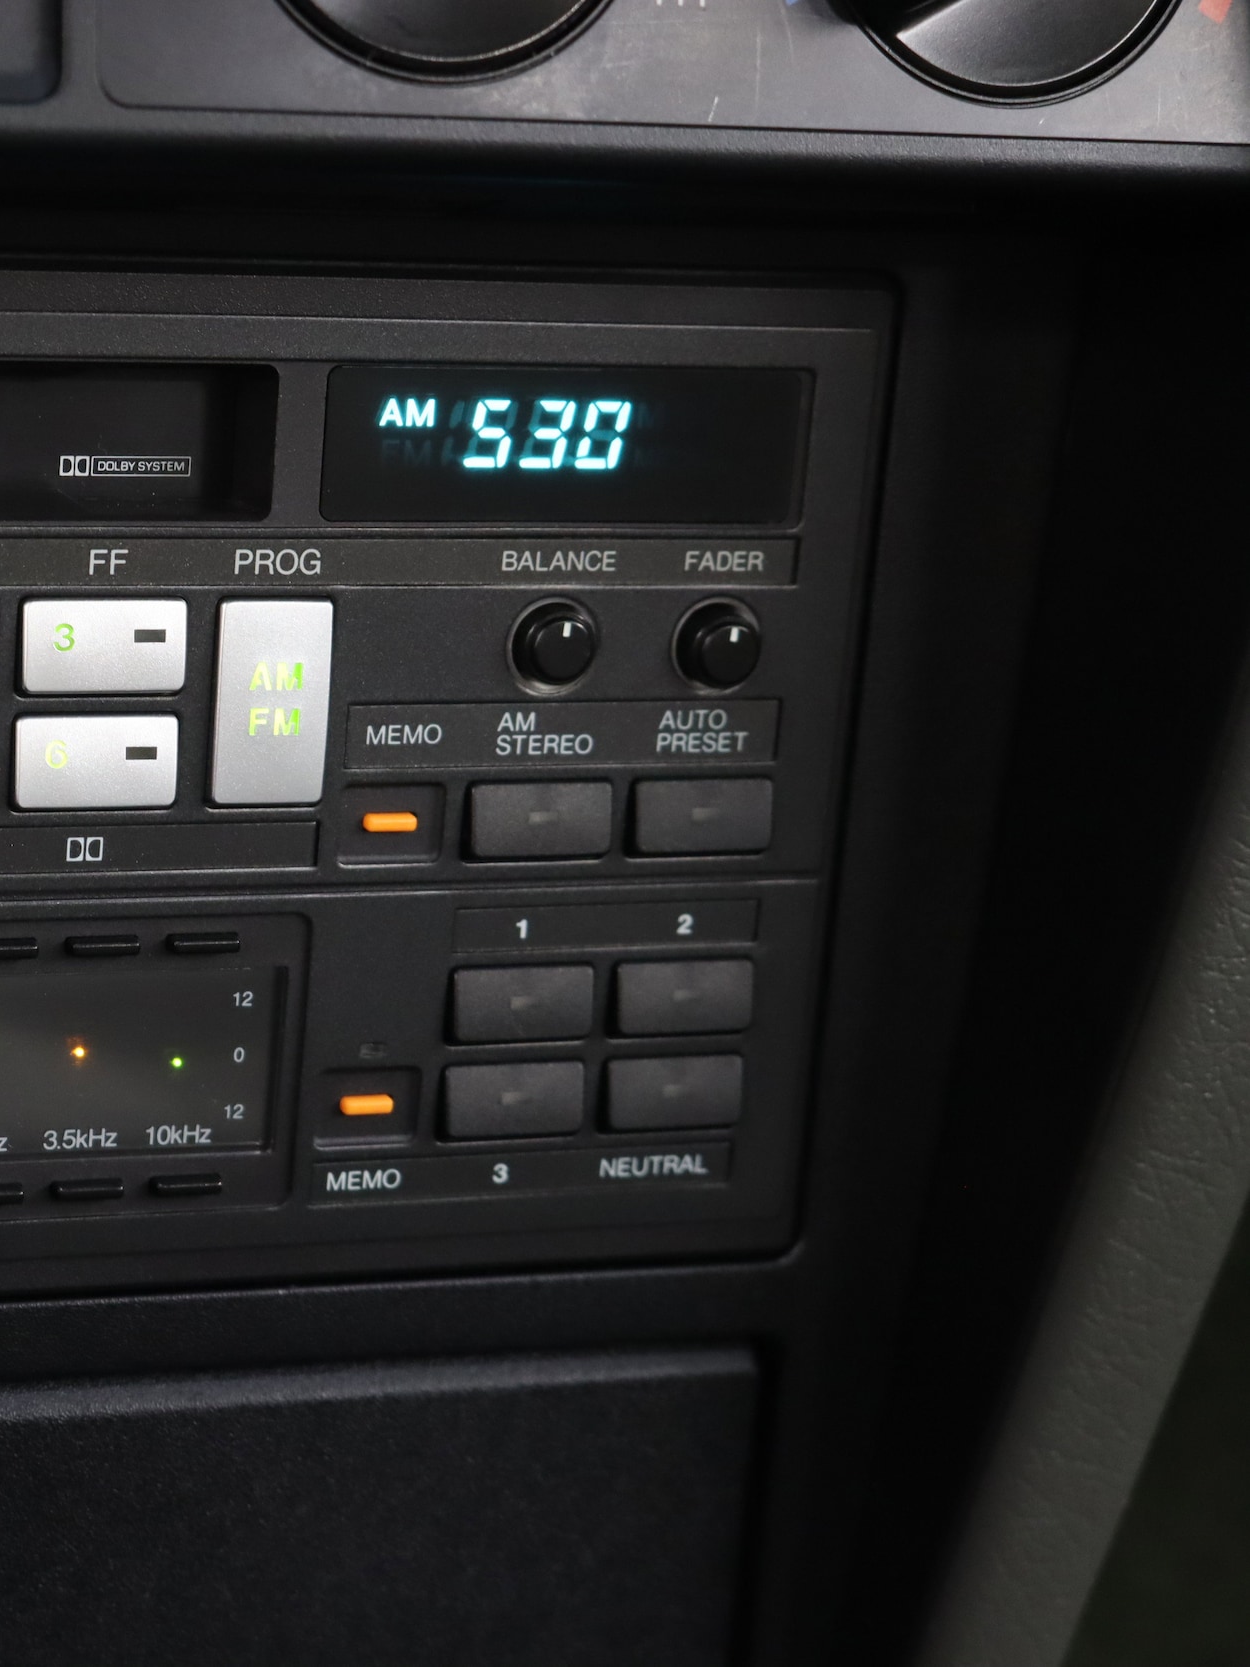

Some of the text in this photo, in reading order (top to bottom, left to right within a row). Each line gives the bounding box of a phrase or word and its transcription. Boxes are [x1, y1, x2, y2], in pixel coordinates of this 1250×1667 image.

[378, 397, 632, 470] AM 530
[97, 460, 185, 472] DOLBY SYSTEM
[88, 549, 129, 576] FF
[234, 548, 321, 576] PROG
[501, 550, 617, 572] BALANCE
[684, 550, 764, 572] FADER
[53, 623, 76, 653] 3
[250, 662, 304, 690] AM
[249, 708, 301, 736] FM
[497, 711, 536, 732] AM
[658, 709, 727, 731] AUTO
[366, 723, 442, 745] MEMO
[495, 733, 593, 756] STEREO
[656, 731, 747, 753] PRESET
[45, 739, 70, 770] 6
[516, 919, 528, 939] 1
[676, 913, 694, 935] 2
[233, 990, 254, 1007] 12
[224, 1103, 245, 1120] 12
[43, 1127, 118, 1151] 3.5kHz
[145, 1124, 212, 1146] 10kHz
[492, 1163, 509, 1184] 3
[599, 1154, 707, 1178] NEUTRAL
[326, 1168, 401, 1191] MEMO
